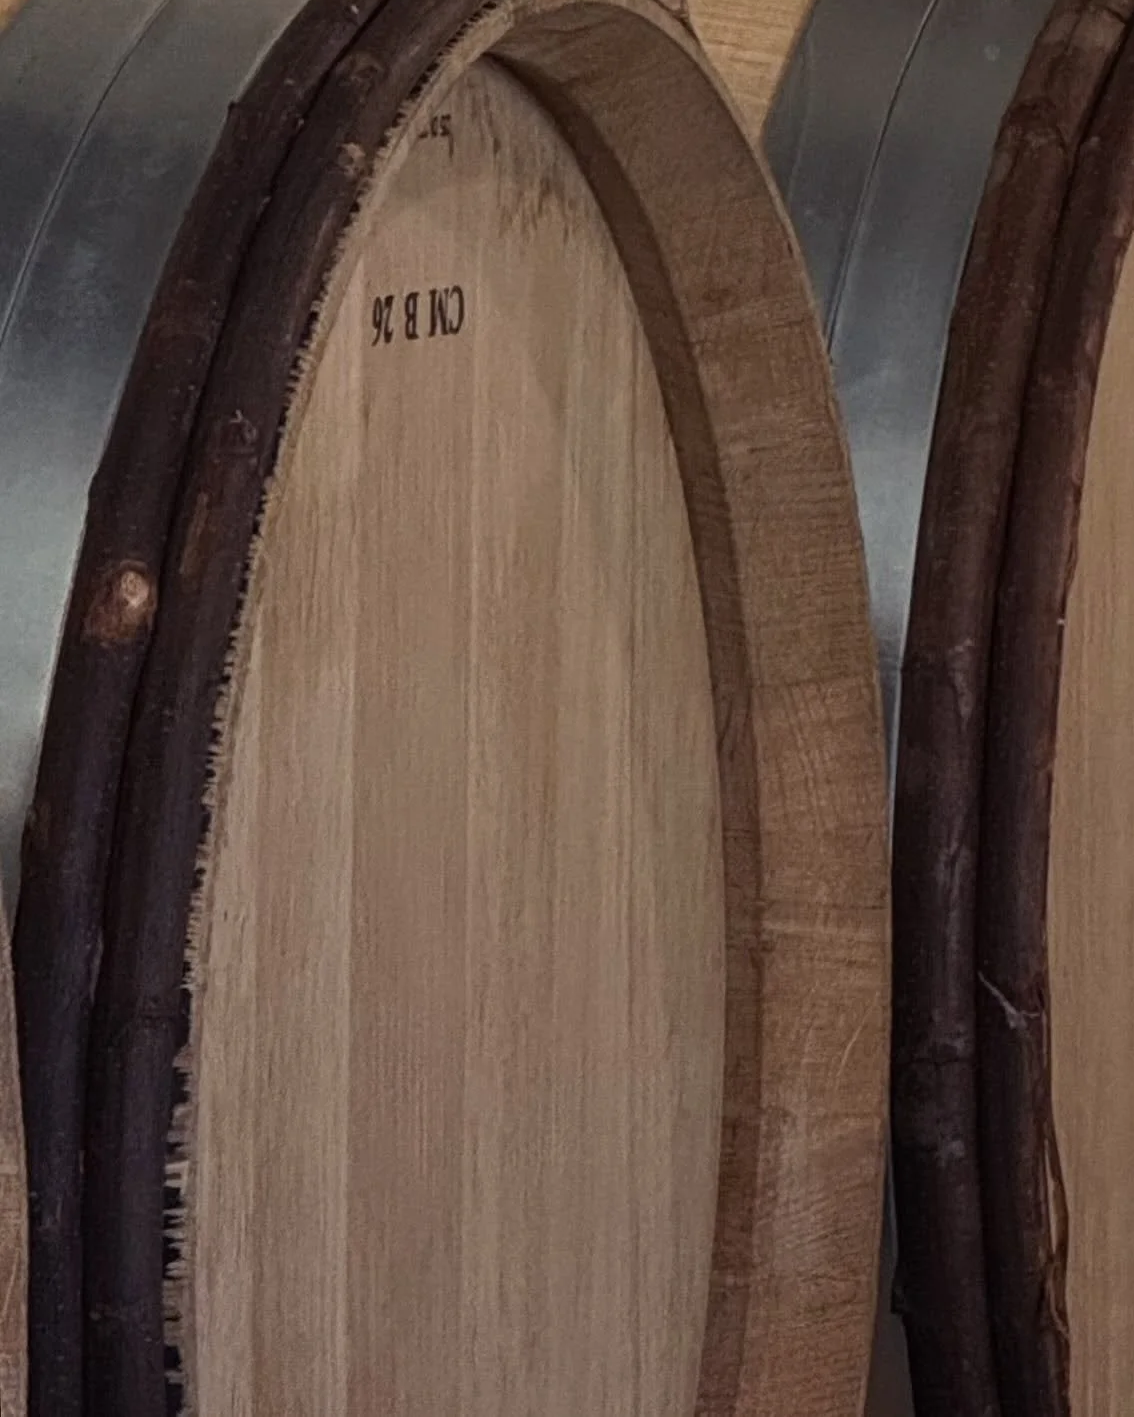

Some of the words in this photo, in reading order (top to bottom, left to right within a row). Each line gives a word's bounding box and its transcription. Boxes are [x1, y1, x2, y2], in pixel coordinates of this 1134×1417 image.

[371, 295, 395, 347] 26
[404, 292, 420, 340] B
[428, 285, 464, 338] CM
